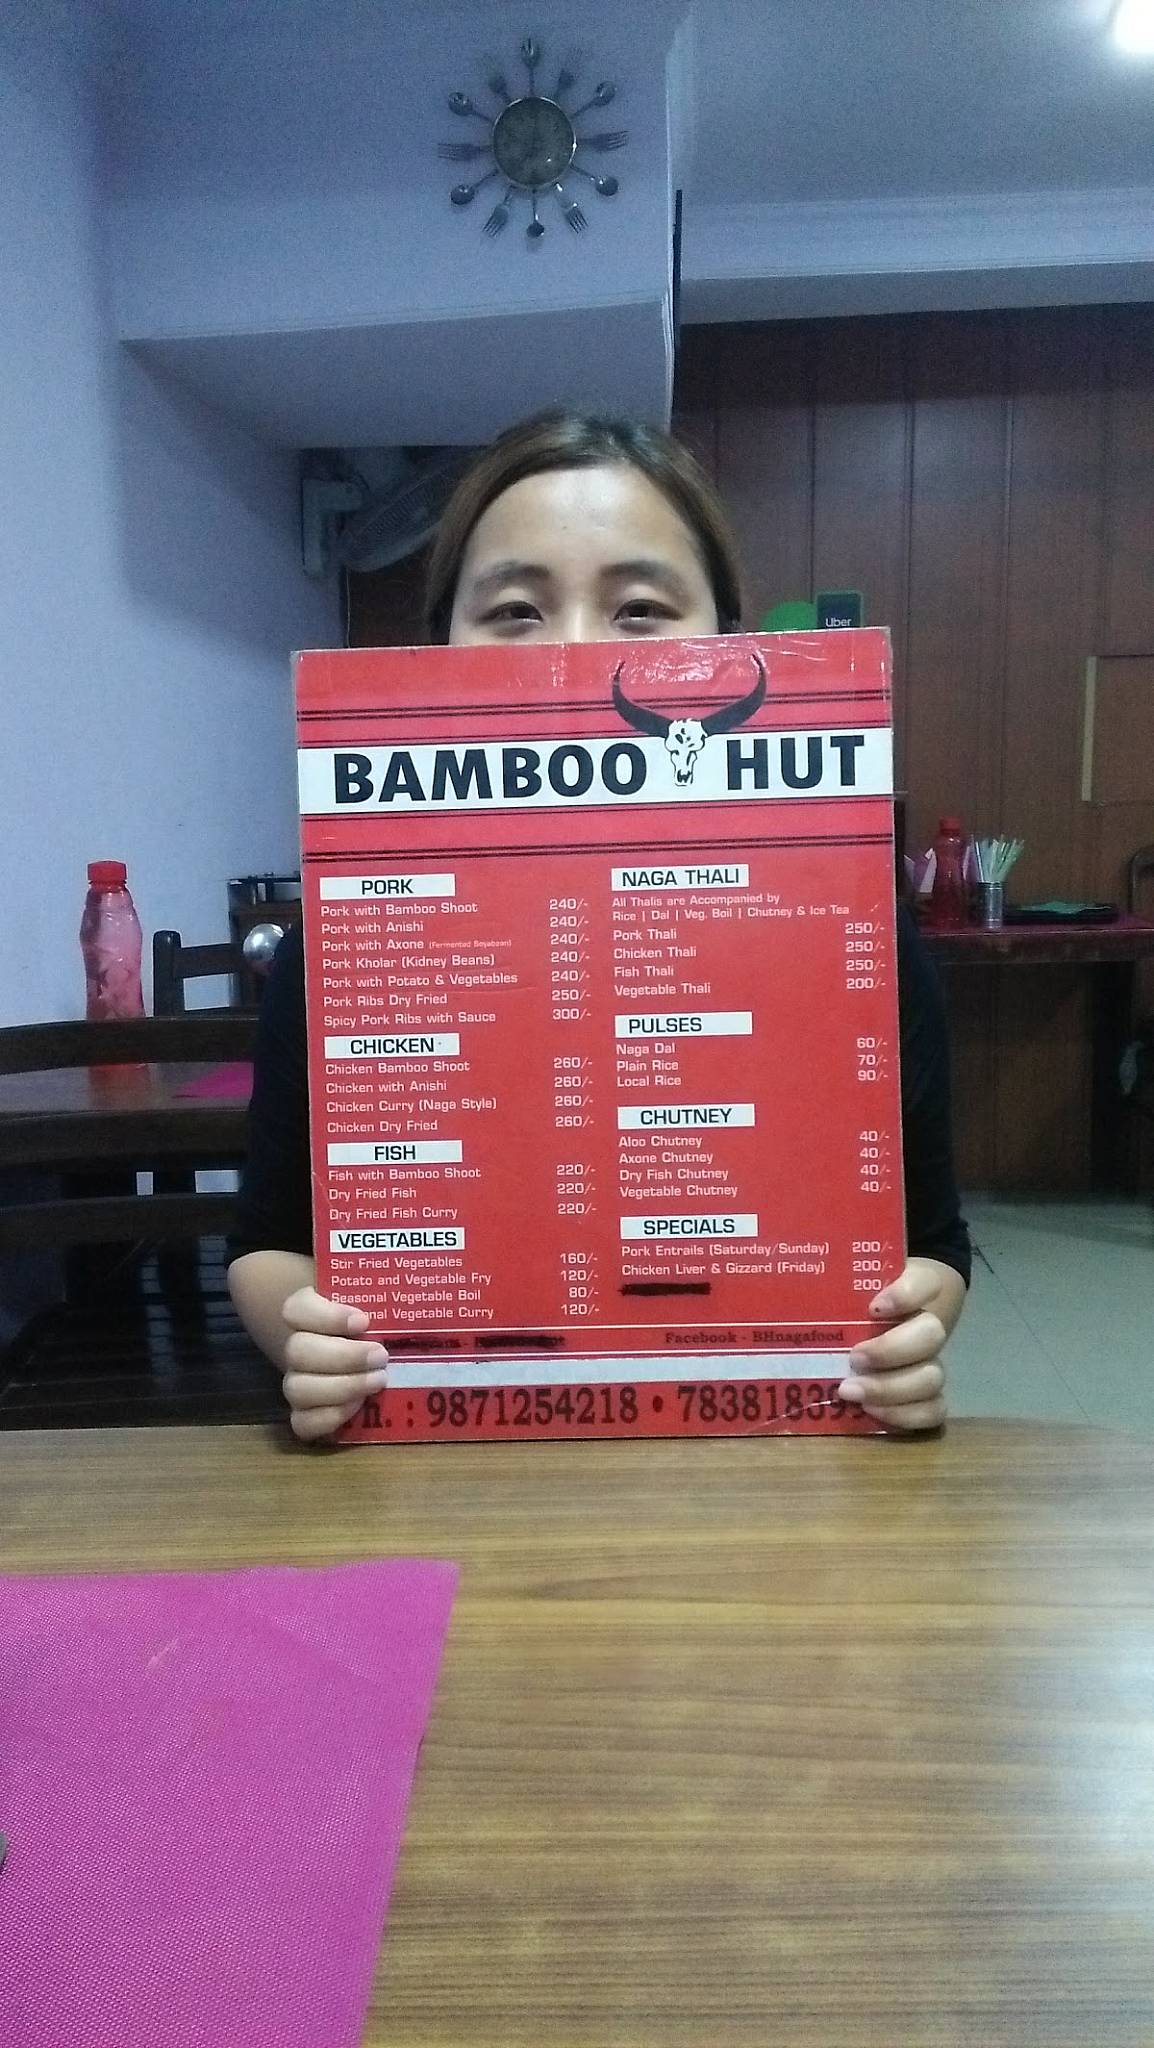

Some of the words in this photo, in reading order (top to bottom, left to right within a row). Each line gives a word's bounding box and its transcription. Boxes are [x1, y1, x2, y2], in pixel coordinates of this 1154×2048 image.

[826, 618, 852, 627] Uber
[333, 742, 647, 804] BAMBOO
[726, 735, 865, 790] HUT
[622, 871, 677, 887] NAGA
[685, 869, 739, 884] THALI
[361, 879, 414, 895] PORK
[549, 898, 588, 911] 240/-
[612, 897, 626, 907] All
[630, 896, 662, 906] Thalis
[667, 897, 685, 905] are
[690, 894, 762, 905] Accompanied
[767, 894, 779, 904] by
[321, 906, 350, 917] Pork
[354, 905, 380, 915] with
[386, 904, 436, 914] Bamboo
[441, 902, 478, 913] Shoot
[612, 911, 636, 921] Rice
[652, 910, 669, 920] Dal
[684, 909, 707, 921] Veg.
[712, 909, 732, 918] Boil
[747, 906, 792, 918] Chutney
[810, 905, 825, 915] Ice
[830, 905, 849, 914] Tea
[321, 923, 350, 935] Pork
[355, 922, 381, 933] with
[386, 921, 424, 932] Anishi
[549, 916, 589, 928] 240/-
[613, 929, 642, 940] Pork
[648, 929, 676, 939] Thali
[845, 923, 885, 935] 250/-
[322, 941, 350, 952] Pork
[355, 940, 381, 951] with
[386, 939, 424, 950] Axone
[550, 934, 590, 945] 240/-
[613, 947, 662, 959] Chicken
[667, 946, 697, 957] Thali
[846, 941, 885, 953] 250/-
[322, 958, 351, 970] Pork
[356, 957, 396, 968] Kholar
[401, 955, 447, 969] (Kidney
[452, 954, 495, 967] Beans)
[551, 952, 590, 963] 240/-
[614, 966, 639, 977] Fish
[644, 966, 674, 976] Thali
[846, 959, 886, 971] 250/-
[323, 977, 351, 989] Pork
[356, 976, 382, 987] with
[388, 976, 430, 986] Potato
[449, 973, 518, 987] Vegetables
[551, 970, 590, 982] 240/-
[846, 977, 886, 990] 200/-
[551, 990, 591, 1001] 250/-
[614, 984, 676, 998] Vegetable
[681, 983, 711, 994] Thali
[323, 996, 352, 1007] Pork
[357, 995, 384, 1006] Ribs
[389, 995, 411, 1007] Dry
[416, 994, 447, 1005] Fried
[324, 1015, 356, 1029] Spicy
[361, 1014, 390, 1025] Pork
[395, 1013, 421, 1024] Ribs
[426, 1012, 453, 1023] with
[458, 1011, 495, 1022] Sauce
[552, 1008, 591, 1020] 300/-
[629, 1017, 702, 1033] PULSES
[350, 1038, 434, 1054] CHICKEN
[616, 1044, 650, 1056] Naga
[655, 1043, 676, 1054] Dal
[856, 1037, 888, 1049] 60/-
[554, 1057, 593, 1069] 260/-
[616, 1060, 647, 1071] Plain
[652, 1059, 679, 1070] Rice
[857, 1054, 888, 1066] 70/-
[325, 1063, 373, 1075] Chicken
[378, 1062, 428, 1073] Bamboo
[433, 1061, 470, 1072] Shoot
[554, 1076, 593, 1088] 260/-
[617, 1076, 650, 1087] Local
[655, 1075, 681, 1086] Rice
[858, 1070, 888, 1081] 90/-
[326, 1082, 373, 1094] Chicken
[378, 1081, 405, 1092] with
[409, 1080, 447, 1091] Anishi
[326, 1101, 374, 1113] Chicken
[379, 1100, 414, 1113] Curry
[419, 1099, 456, 1112] (Naga
[461, 1098, 497, 1110] Style)
[555, 1095, 594, 1107] 260/-
[555, 1115, 594, 1128] 260/-
[640, 1108, 732, 1125] CHUTNEY
[327, 1121, 374, 1133] Chicken
[380, 1121, 402, 1134] Dry
[407, 1120, 438, 1131] Fried
[619, 1136, 646, 1147] Aloo
[651, 1135, 703, 1148] Chutney
[859, 1131, 890, 1142] 40/-
[374, 1145, 416, 1161] FISH
[619, 1153, 657, 1164] Axone
[662, 1152, 714, 1165] Chutney
[860, 1148, 890, 1159] 40/-
[328, 1170, 353, 1181] Fish
[358, 1169, 384, 1180] with
[389, 1168, 440, 1180] Bamboo
[445, 1167, 481, 1179] Shoot
[556, 1164, 596, 1176] 220/-
[620, 1170, 642, 1183] Dry
[647, 1169, 672, 1180] Fish
[677, 1168, 729, 1181] Chutney
[860, 1164, 891, 1176] 40/-
[329, 1189, 350, 1202] Dry
[356, 1188, 386, 1199] Fried
[392, 1187, 416, 1198] Fish
[556, 1183, 596, 1195] 220/-
[620, 1186, 682, 1200] Vegetable
[687, 1184, 738, 1198] Chutney
[329, 1209, 351, 1223] Dry
[356, 1208, 387, 1219] Fried
[393, 1207, 417, 1218] Fish
[422, 1207, 458, 1220] Curry
[557, 1203, 597, 1215] 220/-
[644, 1219, 735, 1235] SPECIALS
[338, 1231, 457, 1249] VEGETABLES
[622, 1246, 650, 1257] Pork
[656, 1244, 704, 1256] Entrails
[709, 1242, 830, 1258] (Saturday/Sunday)
[852, 1241, 893, 1254] 200/-
[331, 1258, 354, 1270] Stir
[359, 1258, 390, 1269] Fried
[394, 1256, 463, 1271] Vegetables
[560, 1253, 598, 1265] 160/-
[622, 1264, 670, 1276] Chicken
[676, 1263, 706, 1274] Liver
[726, 1262, 772, 1274] Gizzard
[777, 1260, 825, 1274] (Friday)
[853, 1260, 894, 1272] 200/-
[331, 1275, 373, 1286] Potato
[378, 1274, 400, 1285] and
[405, 1273, 466, 1288] Vegetable
[471, 1273, 492, 1286] Fry
[560, 1270, 598, 1282] 120/-
[331, 1291, 387, 1304] Seasonal
[392, 1290, 453, 1305] Vegetable
[458, 1289, 481, 1301] Boil
[569, 1287, 599, 1299] 80/-
[393, 1307, 454, 1321] Vegetable
[458, 1307, 494, 1320] Curry
[561, 1304, 600, 1316] 120/-
[665, 1332, 736, 1344] Facebook
[426, 1385, 638, 1428] 9871254218
